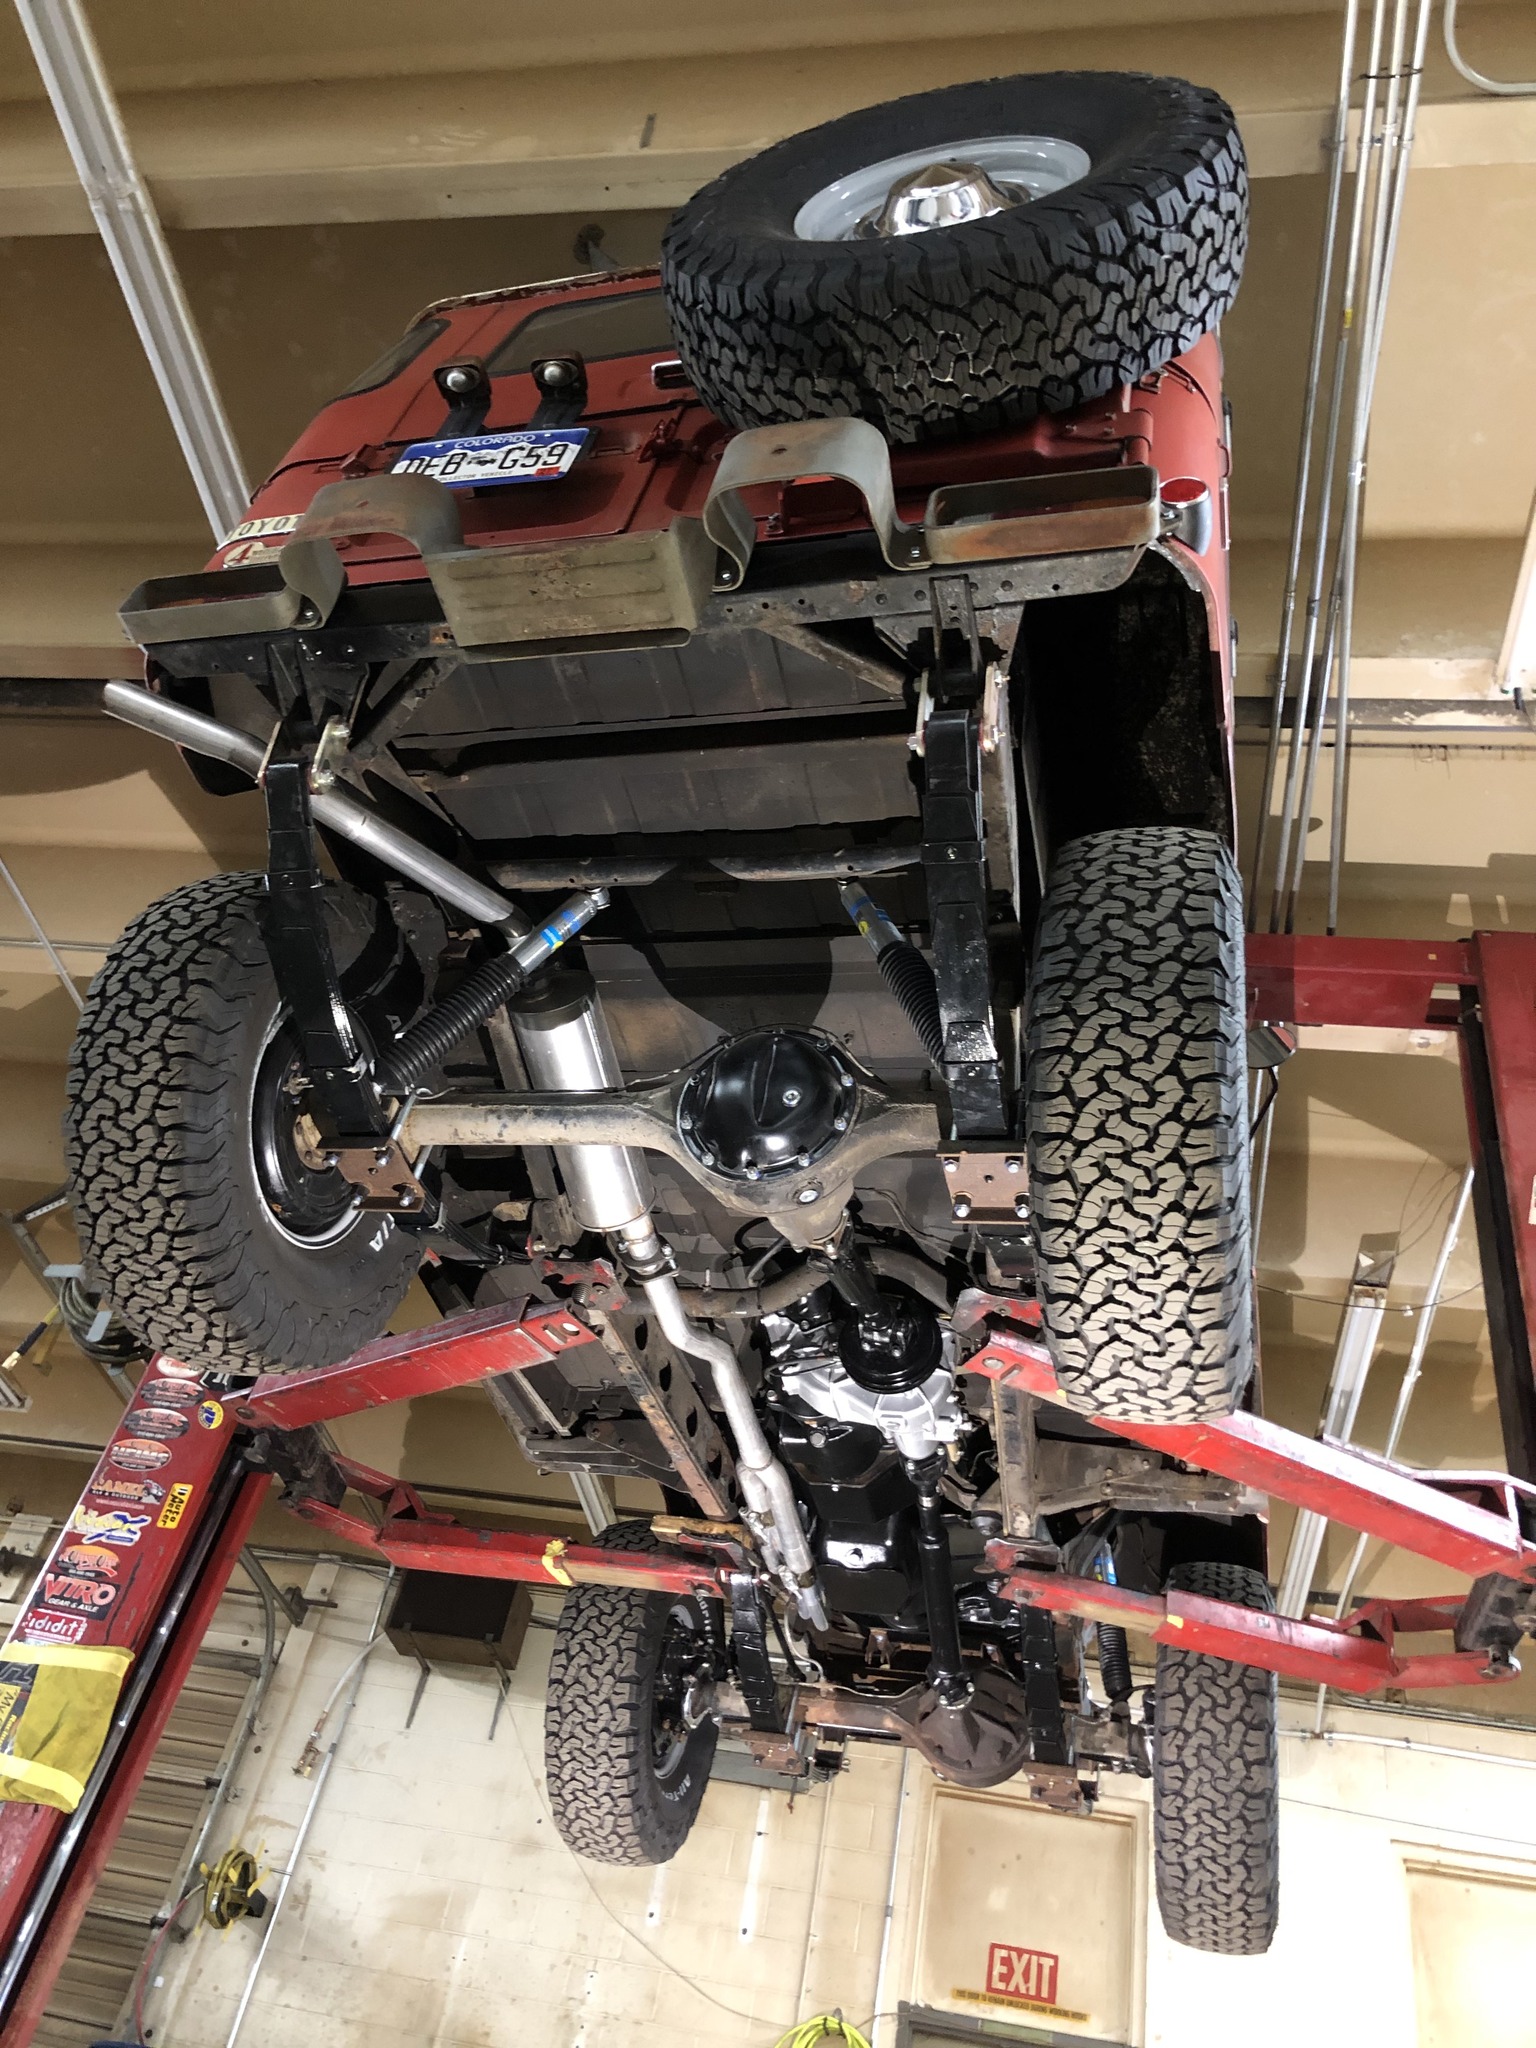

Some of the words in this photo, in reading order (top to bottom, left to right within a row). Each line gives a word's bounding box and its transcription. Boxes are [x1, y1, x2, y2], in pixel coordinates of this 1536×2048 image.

[454, 434, 536, 449] COLORADO
[498, 443, 569, 470] G59
[225, 515, 304, 540] TOYOT
[228, 543, 254, 564] 4
[990, 1947, 1055, 1999] EXIT
